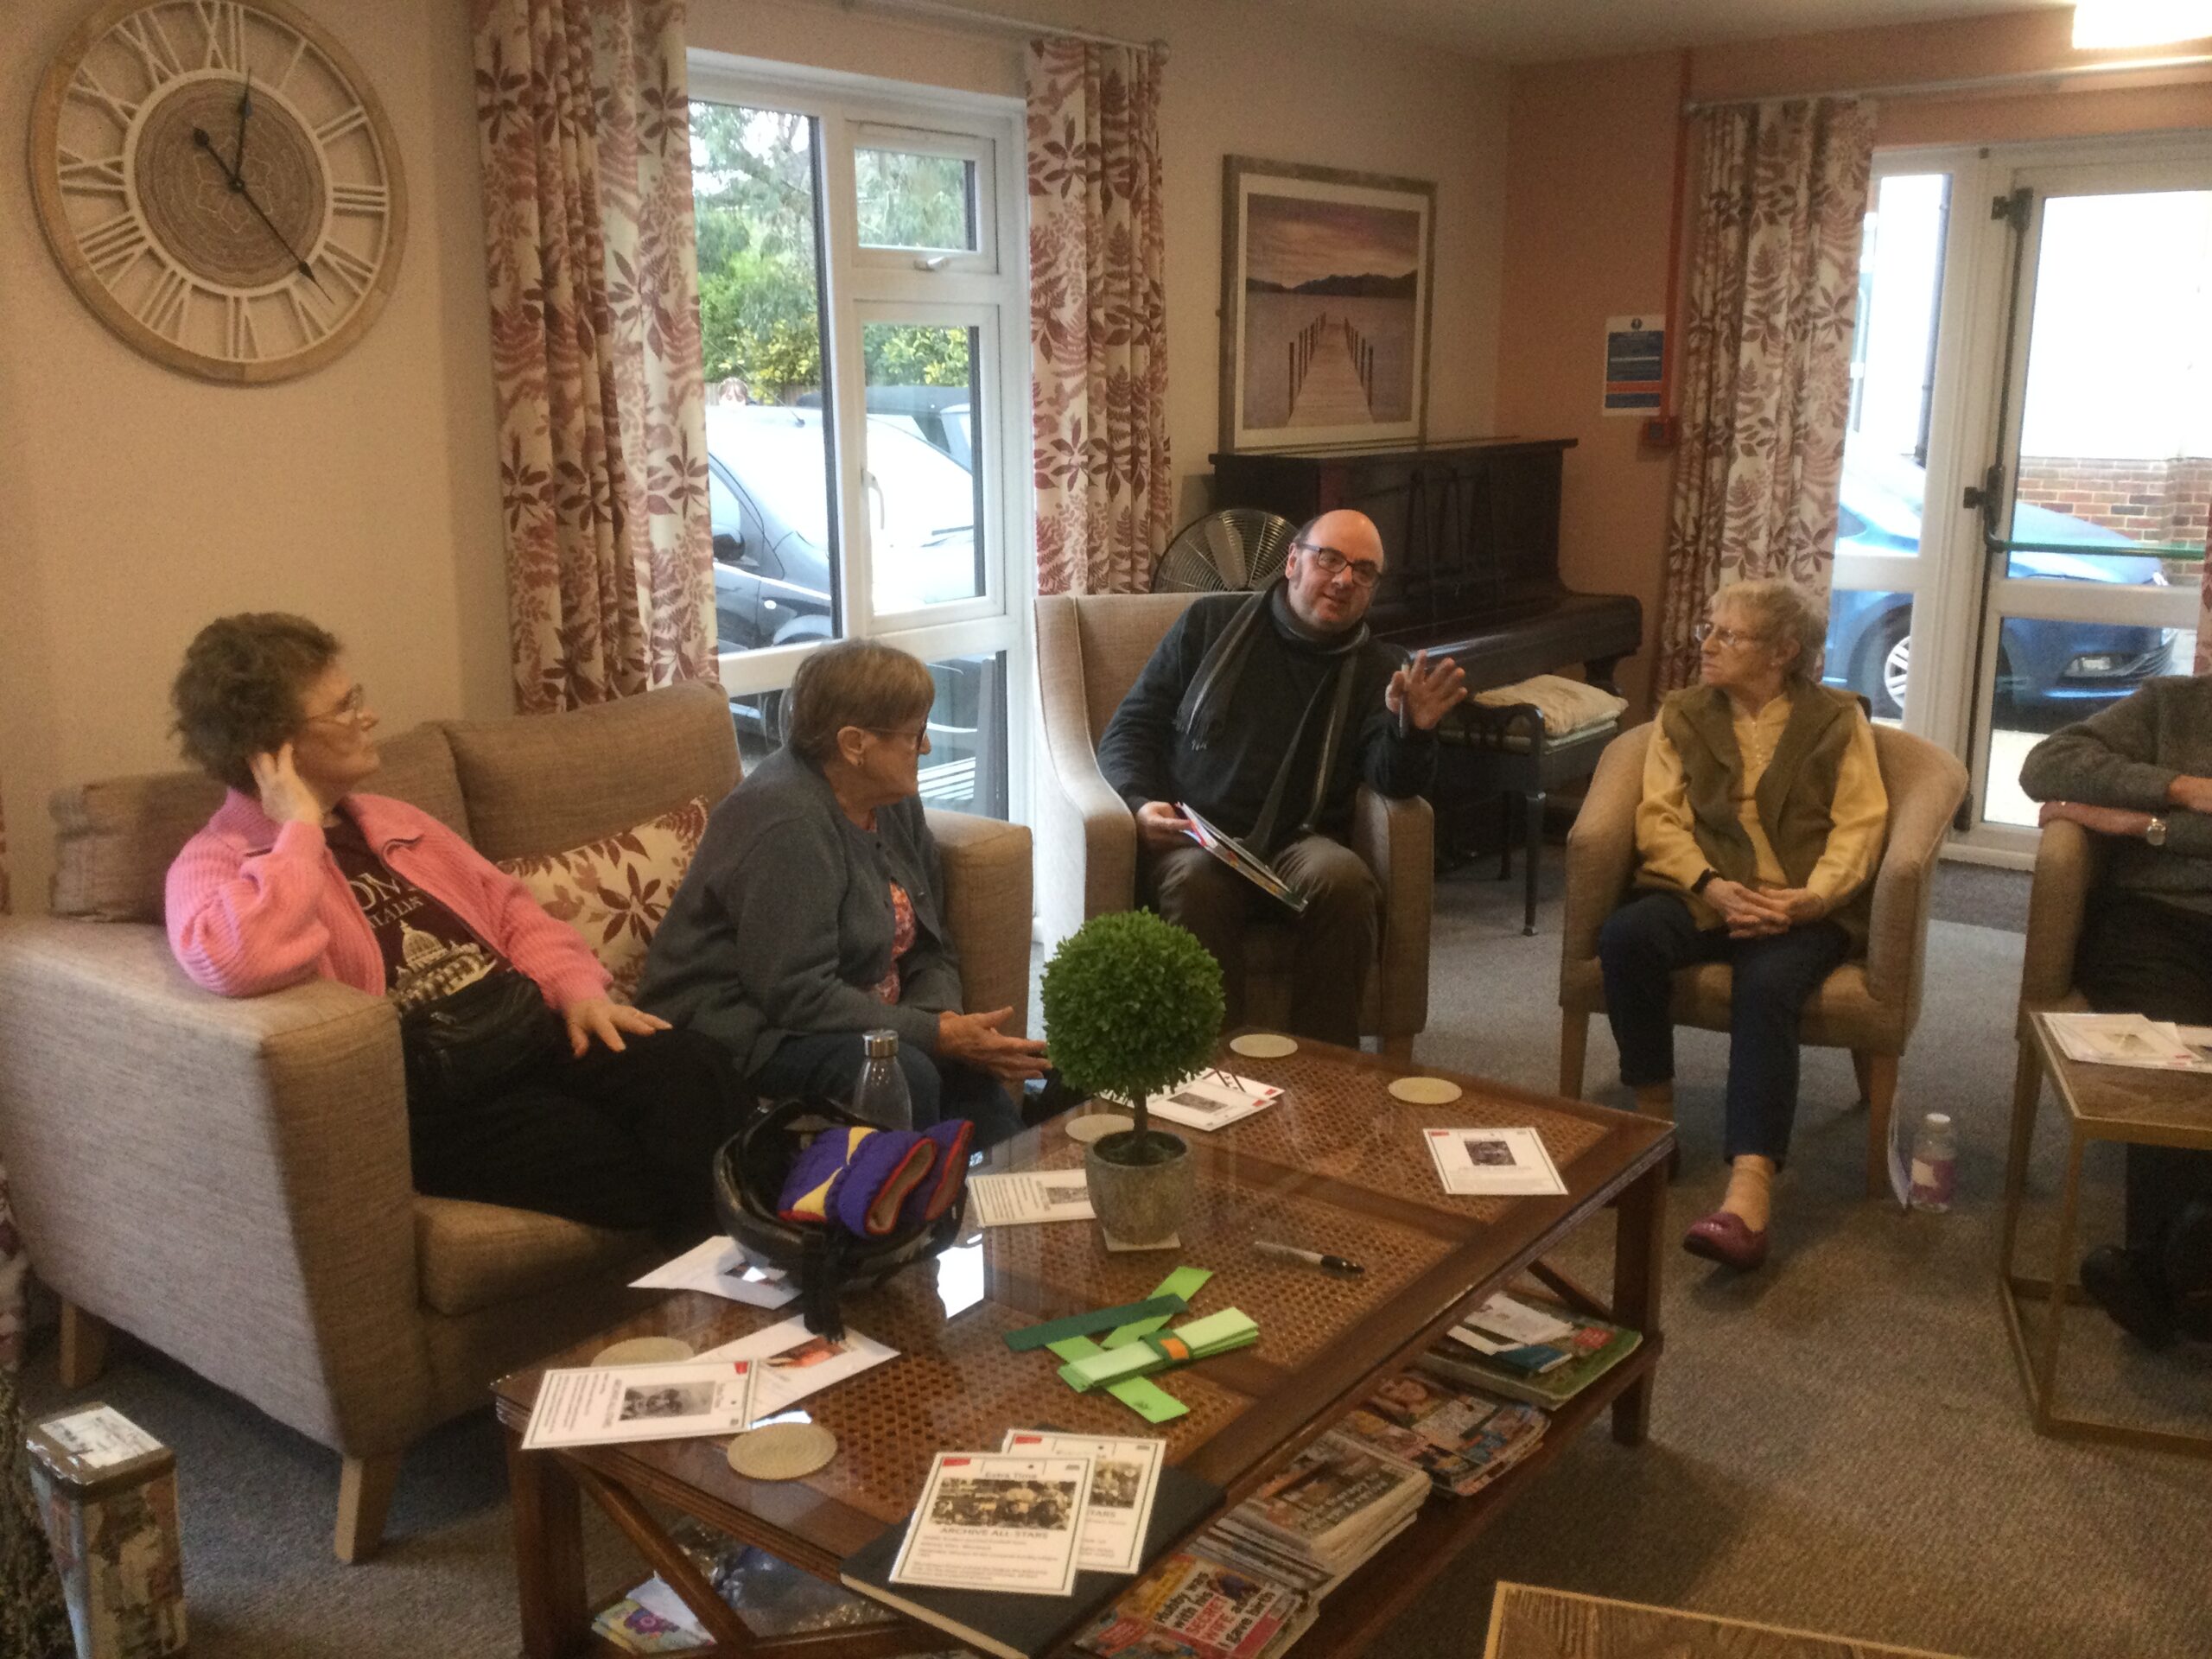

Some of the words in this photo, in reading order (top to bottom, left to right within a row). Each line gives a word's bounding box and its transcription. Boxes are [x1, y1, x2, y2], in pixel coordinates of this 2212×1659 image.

[195, 1, 245, 76] XII
[331, 183, 386, 213] III
[1087, 1510, 1116, 1518] TARS
[940, 1528, 988, 1536] ARCHIVE
[1014, 1530, 1048, 1540] STARS
[1154, 1591, 1192, 1623] Hubby
[1173, 1605, 1198, 1630] with
[1185, 1595, 1225, 1634] SECRET
[1200, 1611, 1236, 1641] WIFE
[1224, 1617, 1253, 1645] gave
